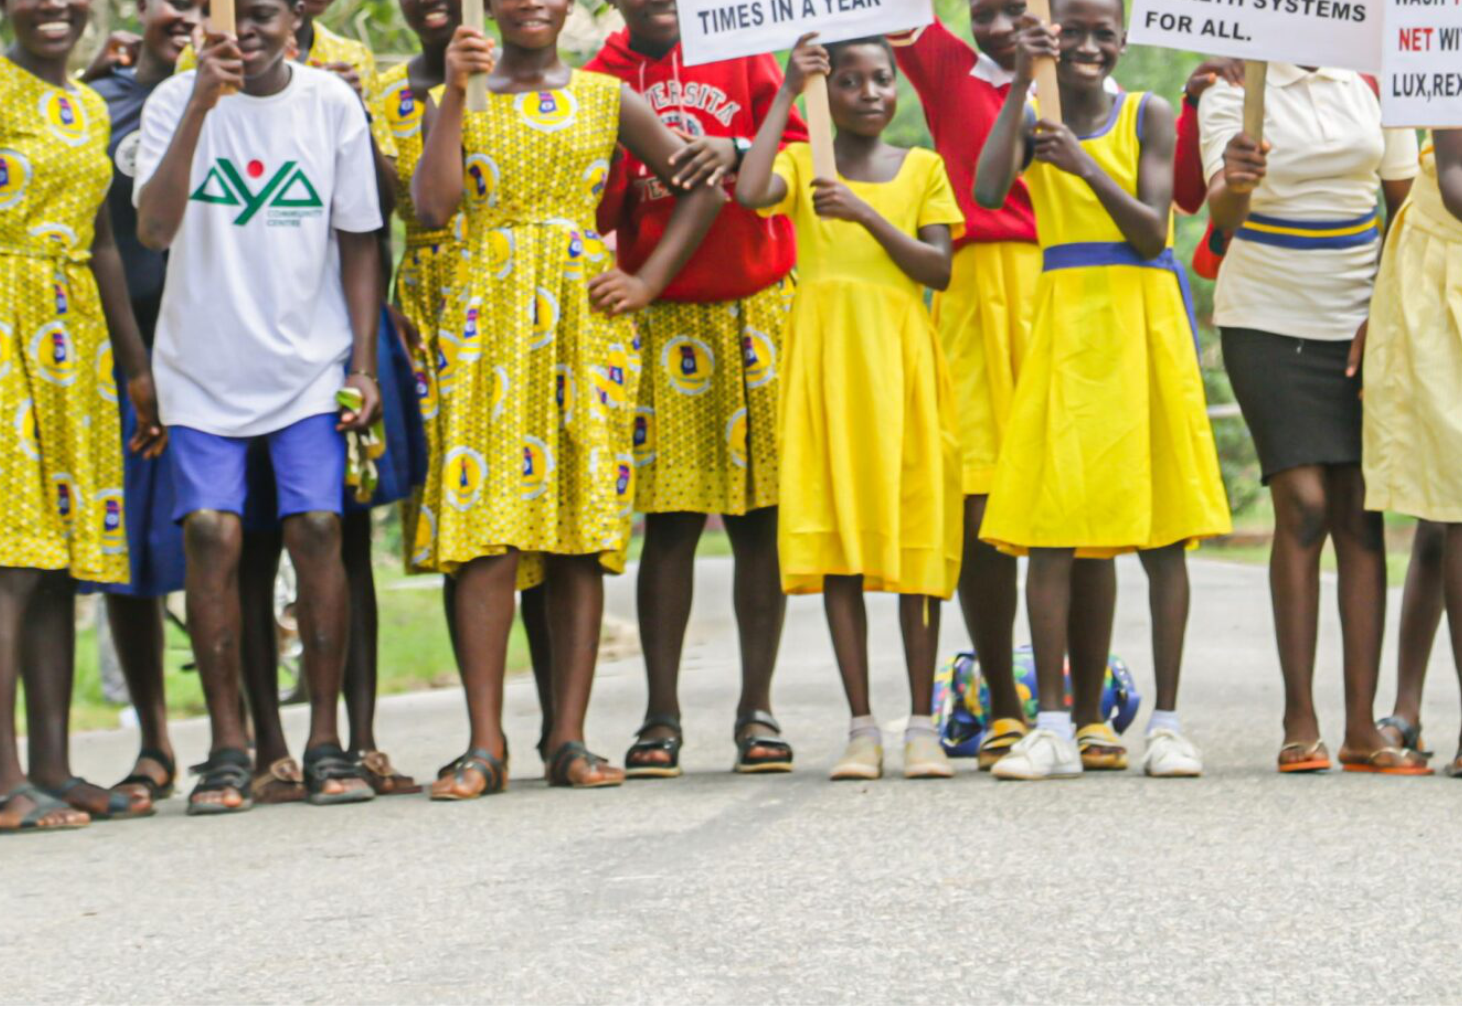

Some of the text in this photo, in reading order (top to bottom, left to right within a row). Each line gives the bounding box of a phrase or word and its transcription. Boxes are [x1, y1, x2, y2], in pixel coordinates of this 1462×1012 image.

[697, 1, 765, 35] TIMES
[1144, 10, 1252, 42] FOR ALL.
[1398, 26, 1435, 52] NET
